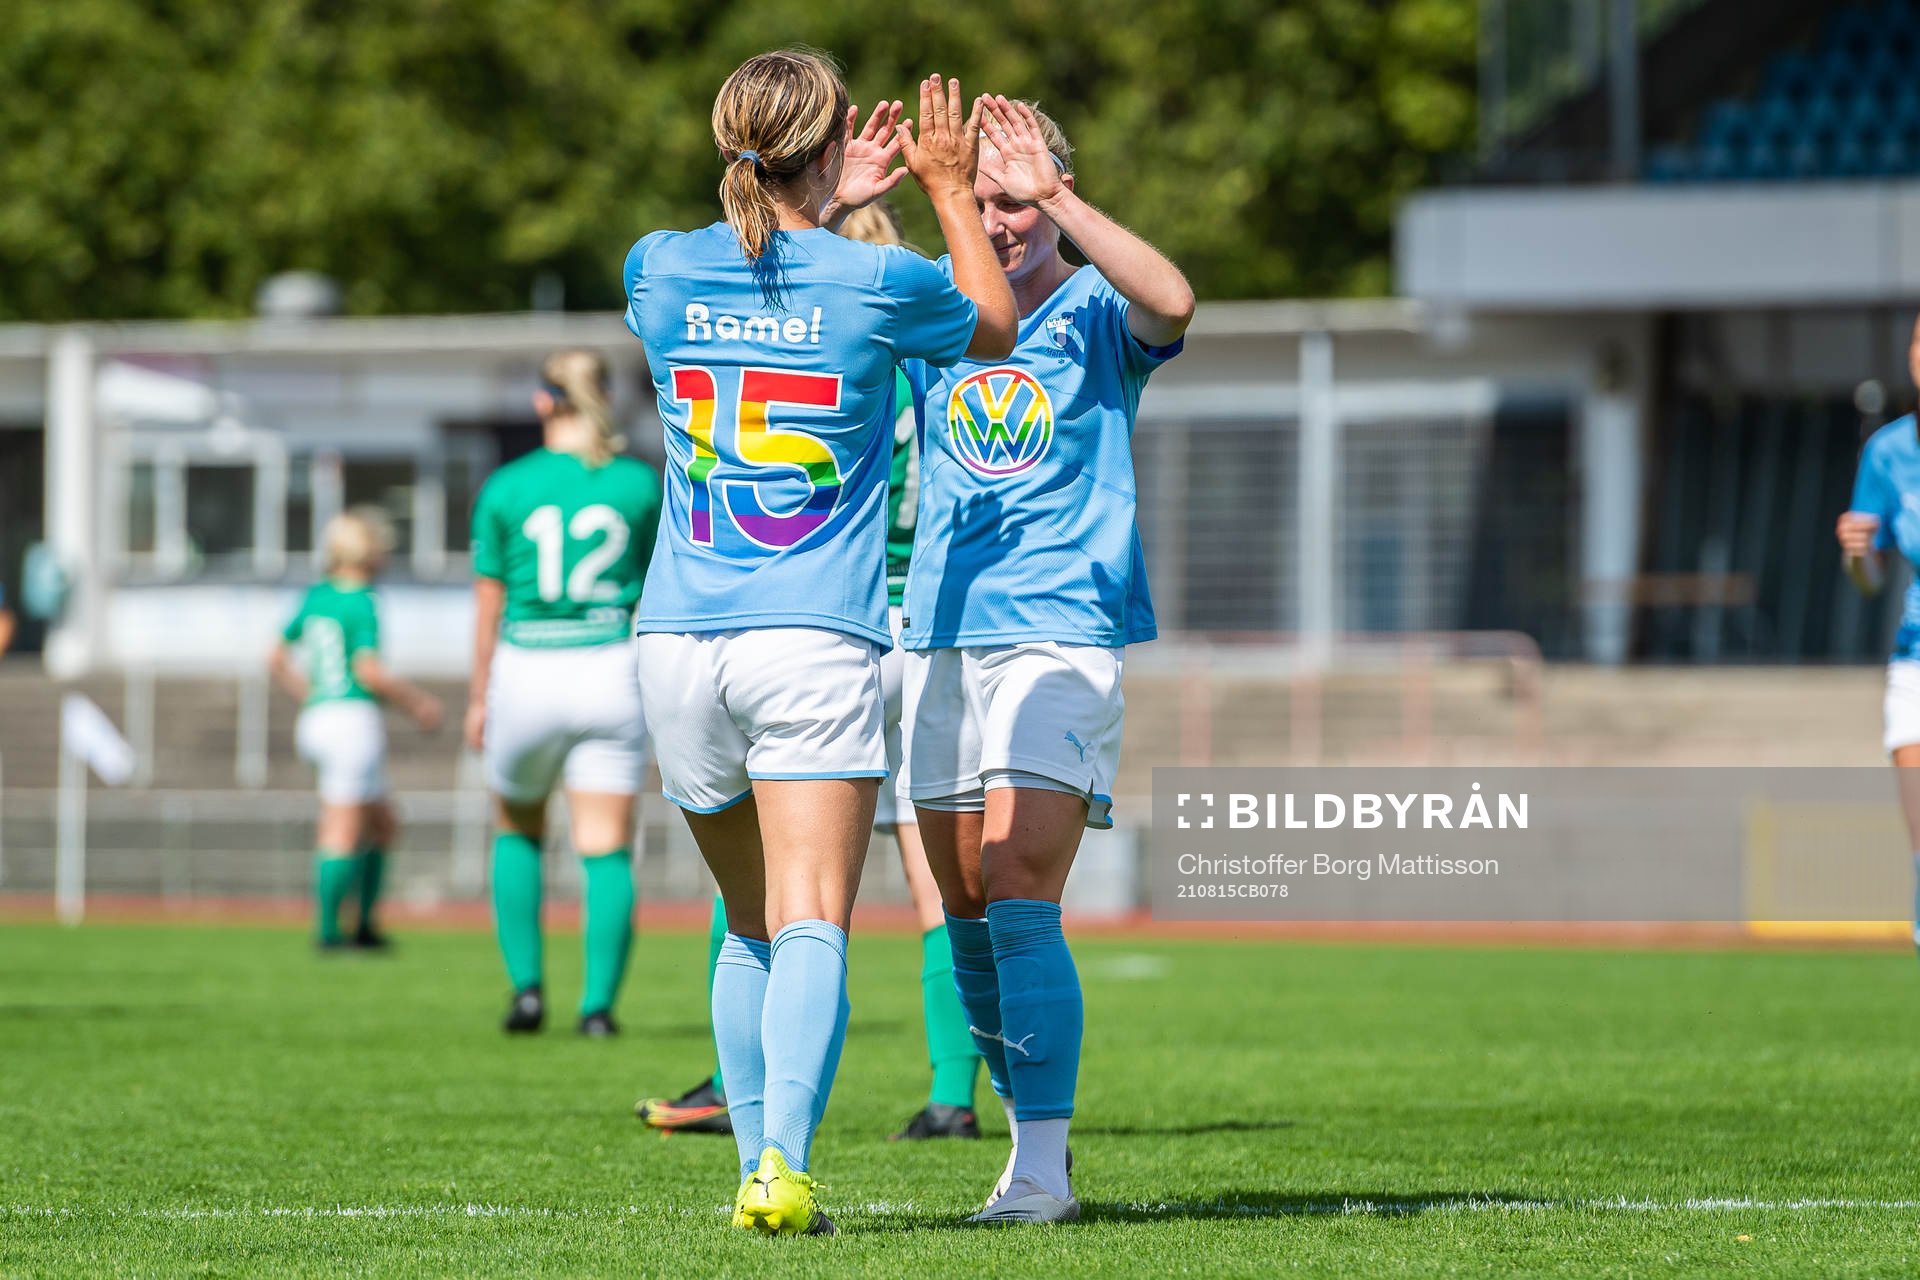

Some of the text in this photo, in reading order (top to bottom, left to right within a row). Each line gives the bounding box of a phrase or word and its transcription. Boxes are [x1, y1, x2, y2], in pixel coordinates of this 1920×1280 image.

[685, 303, 822, 344] Ramel
[669, 364, 844, 551] 15
[522, 503, 630, 603] 12
